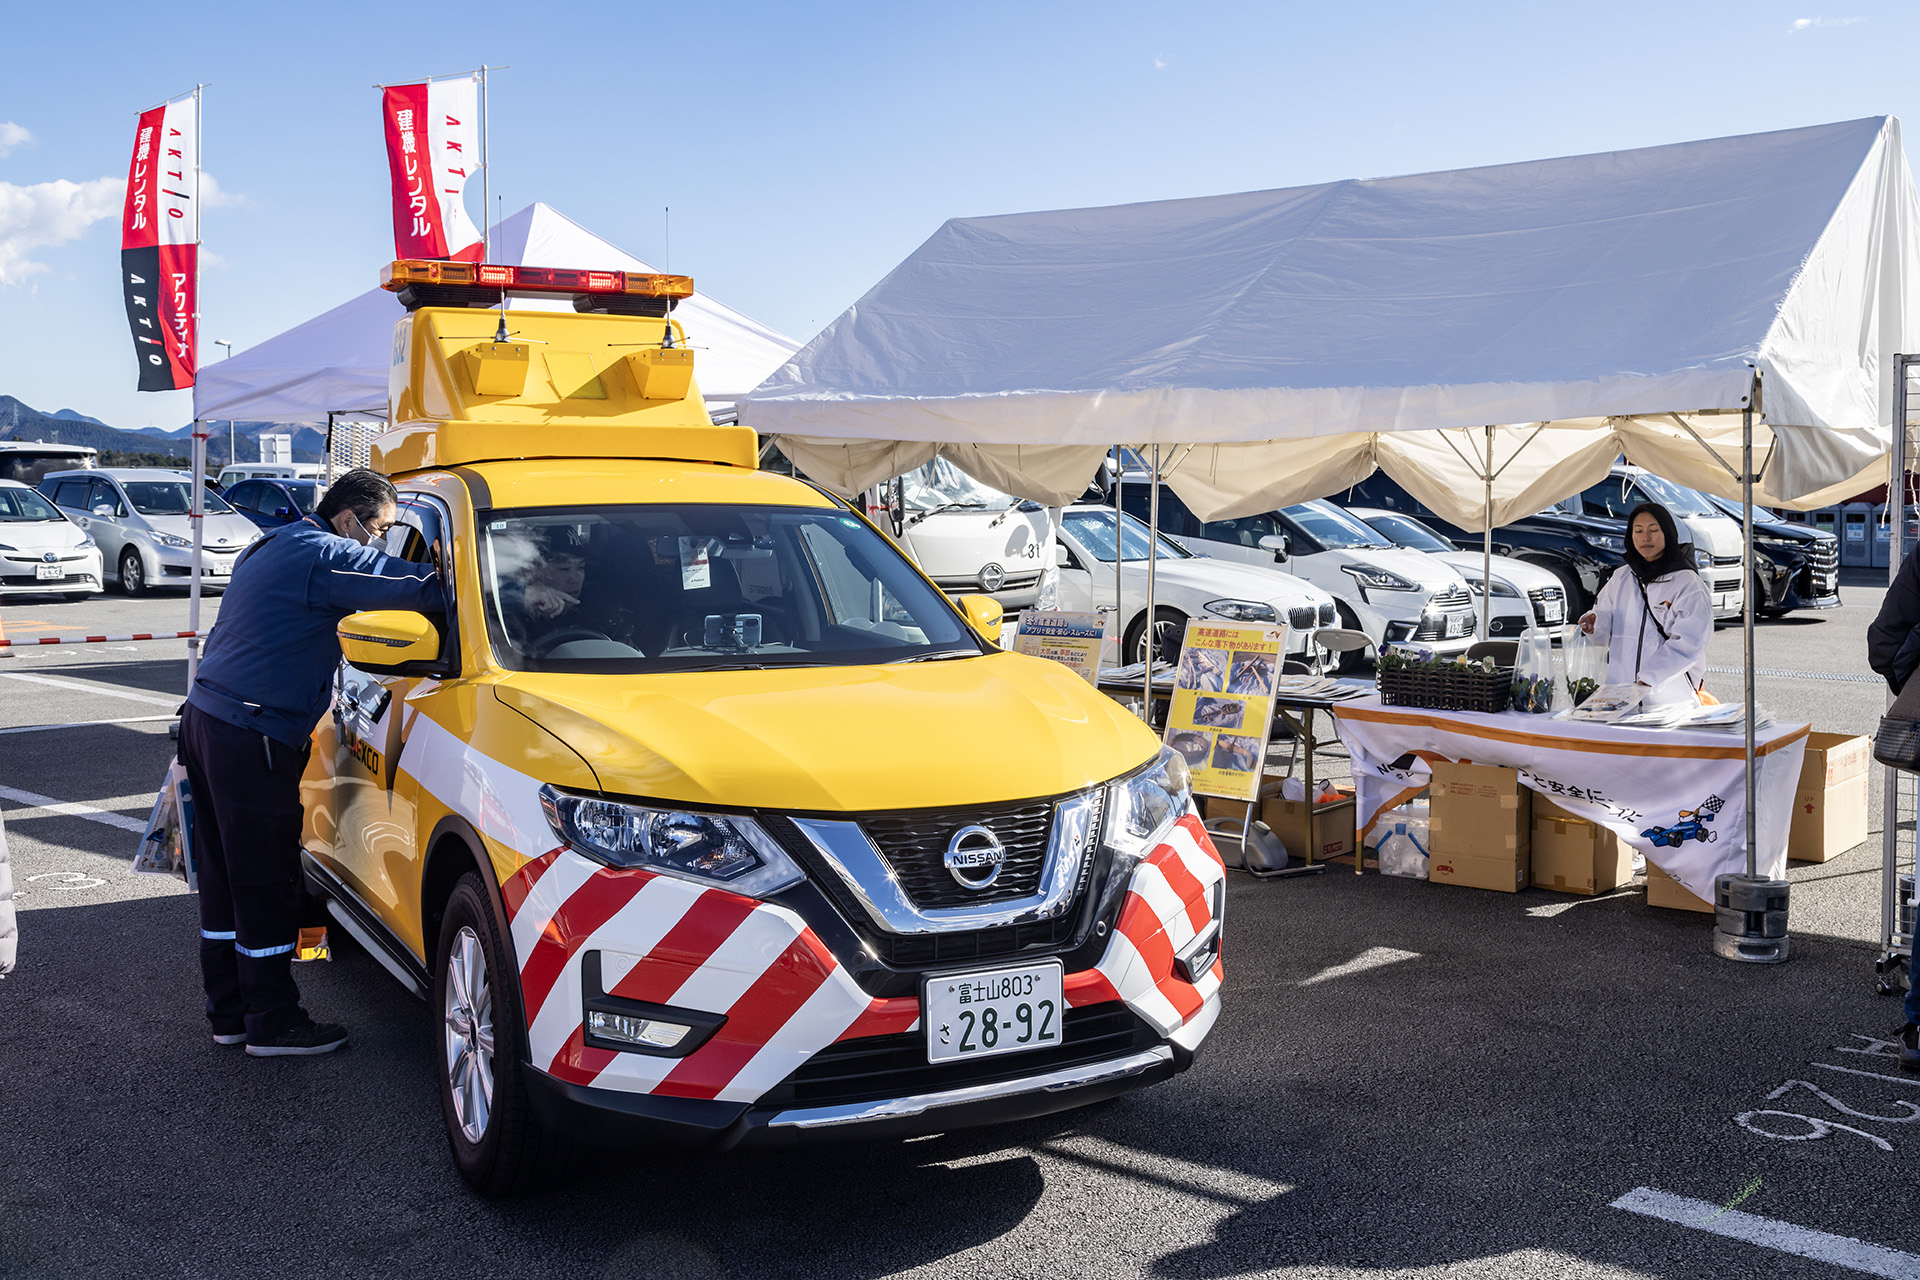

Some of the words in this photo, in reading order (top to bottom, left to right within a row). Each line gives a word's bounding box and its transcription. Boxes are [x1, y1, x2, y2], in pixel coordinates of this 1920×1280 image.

[132, 126, 153, 230] 建機レンタル
[162, 127, 190, 219] AKTIO
[396, 109, 431, 237] 建機レンタル
[130, 273, 163, 366] AKTIO
[1028, 543, 1040, 559] 31
[1197, 628, 1239, 639] 高速道路には
[952, 851, 1002, 865] NISSAN
[958, 975, 1033, 1004] 富士山803
[939, 1023, 950, 1044] さ
[958, 999, 1055, 1053] 28-92
